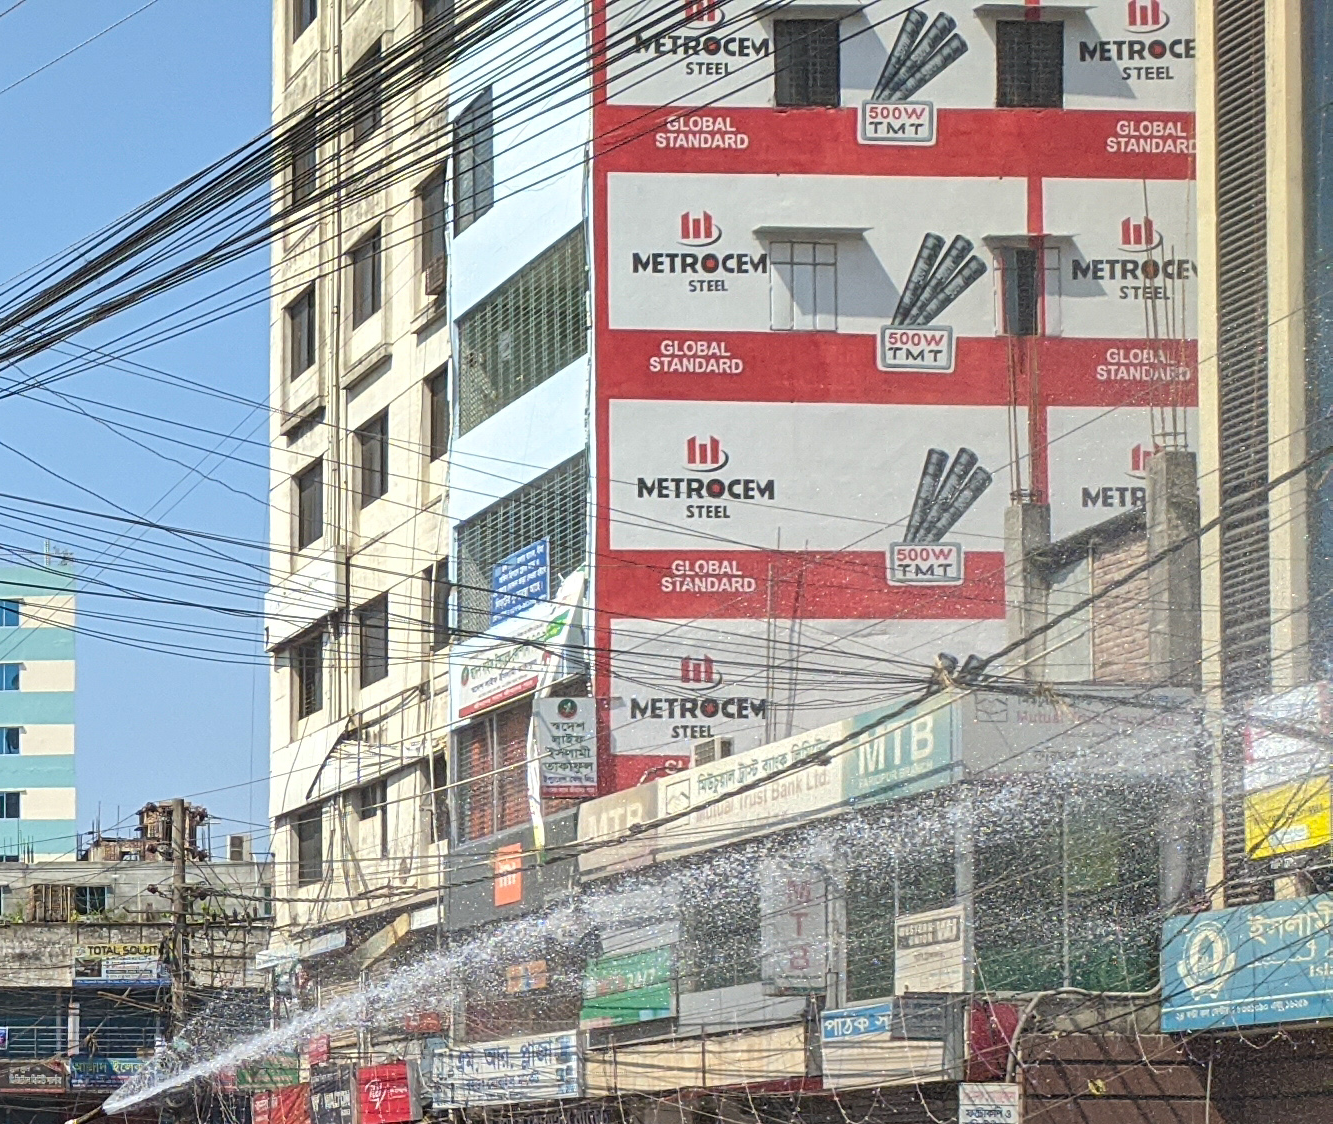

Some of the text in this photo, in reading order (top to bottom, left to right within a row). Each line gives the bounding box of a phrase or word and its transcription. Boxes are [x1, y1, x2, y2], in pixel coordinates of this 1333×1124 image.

[635, 35, 770, 57] METROCEM
[1079, 39, 1196, 62] METROCE
[686, 62, 733, 75] STEEL
[1122, 66, 1174, 80] STEEL
[869, 106, 925, 120] 500W
[667, 116, 736, 131] GLOBAL
[869, 121, 925, 135] TMT
[1117, 121, 1187, 136] GLOBAL
[655, 133, 749, 149] STANDARD
[632, 252, 767, 274] METROCEM
[688, 279, 728, 292] STEEL
[1119, 286, 1171, 300] STEEL
[888, 332, 944, 346] 500W
[661, 340, 730, 356] GLOBAL
[887, 347, 944, 363] TMT
[1107, 349, 1177, 364] GLOBAL
[649, 356, 743, 373] STANDARD
[1097, 366, 1190, 381] STANDARD
[637, 477, 775, 500] METROCEM
[1081, 487, 1146, 508] METR
[686, 505, 730, 519] STEEL
[897, 548, 952, 562] 500W
[671, 560, 742, 575] GLOBAL
[897, 564, 953, 578] TMT
[661, 577, 756, 592] STANDARD
[630, 698, 766, 719] METROCEM
[550, 721, 585, 733] স্বদেশ
[671, 725, 715, 739] STEEL
[551, 735, 585, 747] লাইফ
[858, 714, 934, 777] MTB
[547, 745, 591, 760] ইসলামী
[771, 777, 802, 801] Bank
[87, 945, 158, 955] TOTAL SOLUT
[824, 1015, 869, 1037] পাঠক
